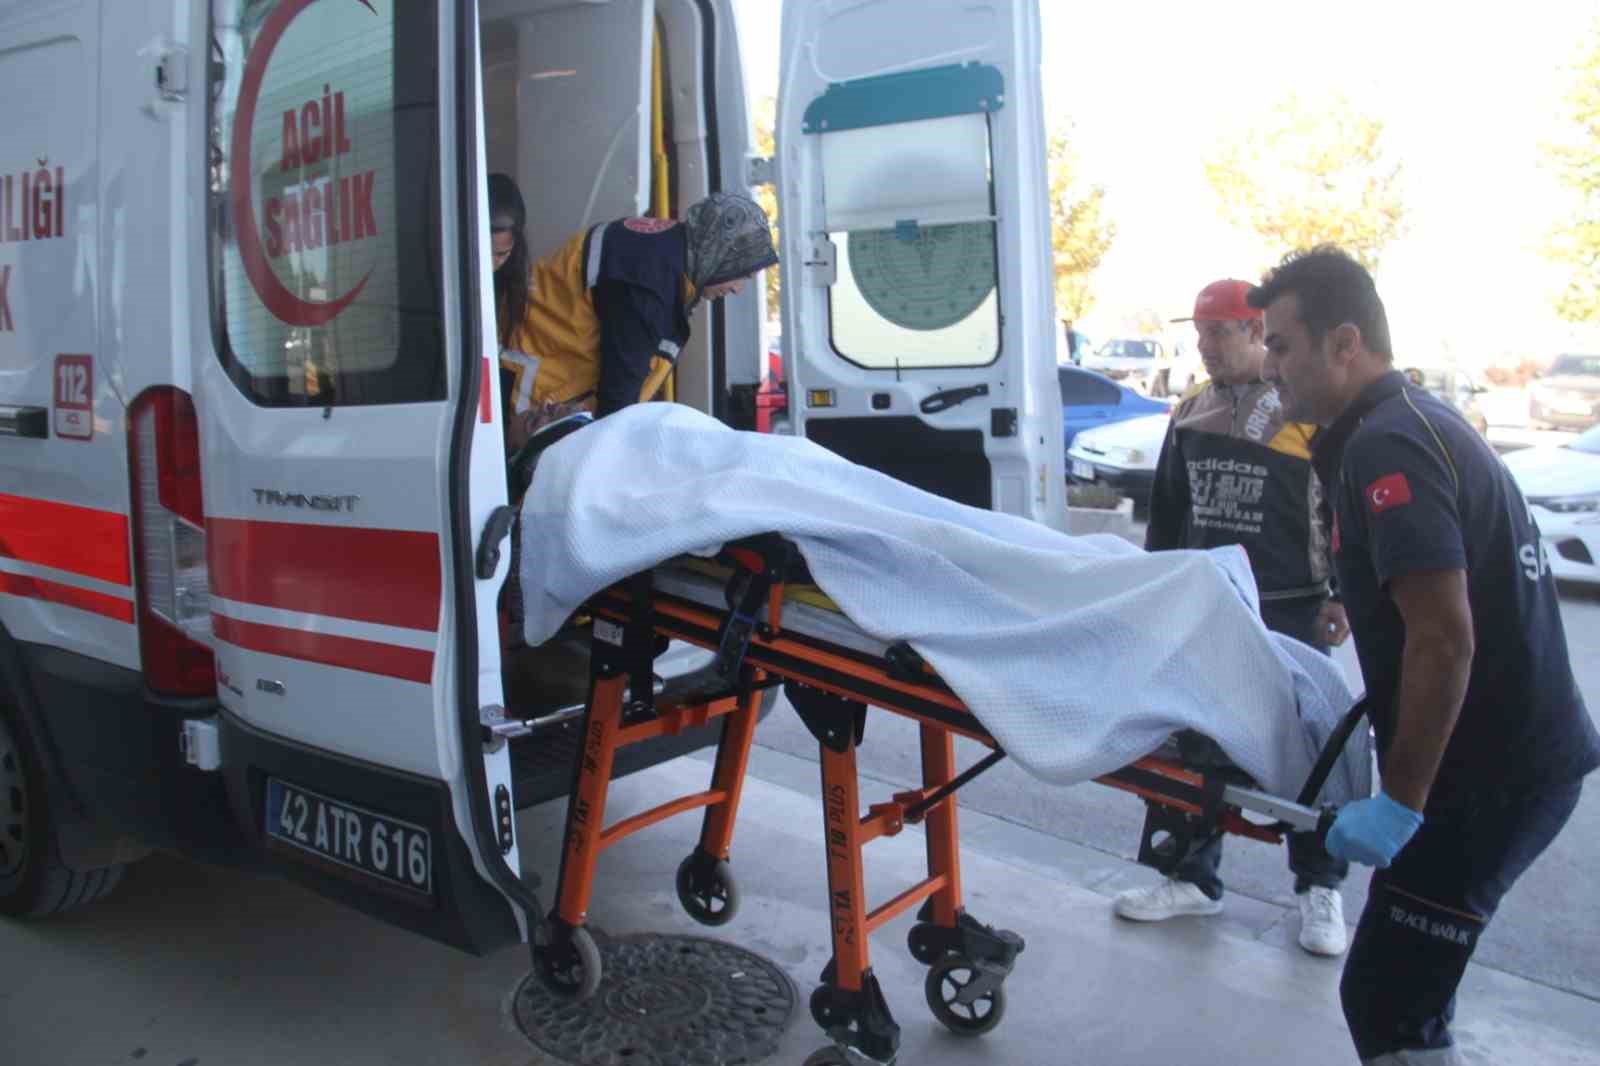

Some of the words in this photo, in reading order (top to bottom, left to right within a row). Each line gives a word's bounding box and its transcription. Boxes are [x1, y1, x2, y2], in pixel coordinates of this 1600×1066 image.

[279, 83, 351, 172] ACİL
[0, 157, 65, 240] LIĞI
[263, 169, 377, 257] SAĞLIK
[59, 364, 88, 405] 112
[250, 487, 361, 513] TRANSIT
[279, 789, 310, 843] 42
[314, 801, 364, 865] ATR
[370, 820, 427, 886] 616
